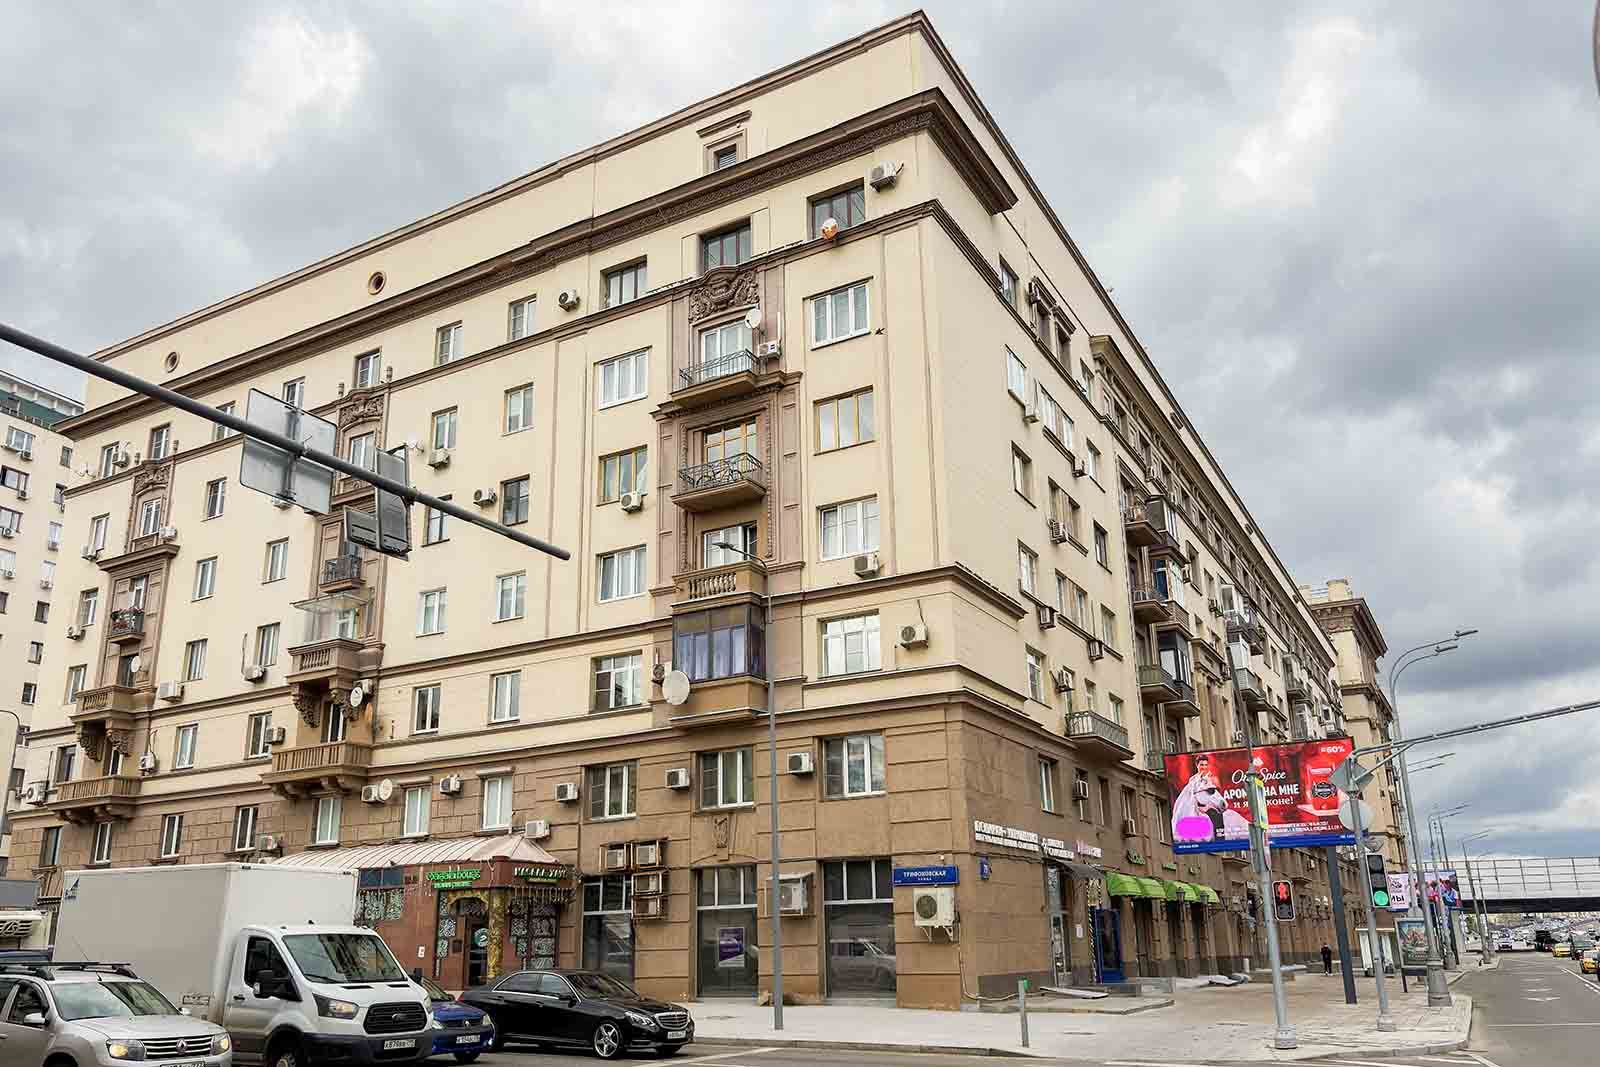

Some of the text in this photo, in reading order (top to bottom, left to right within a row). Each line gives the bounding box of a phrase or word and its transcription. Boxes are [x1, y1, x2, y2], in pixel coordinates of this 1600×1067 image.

[1259, 767, 1286, 782] Spice
[1279, 783, 1300, 795] МНЕ
[1267, 796, 1294, 806] коне!
